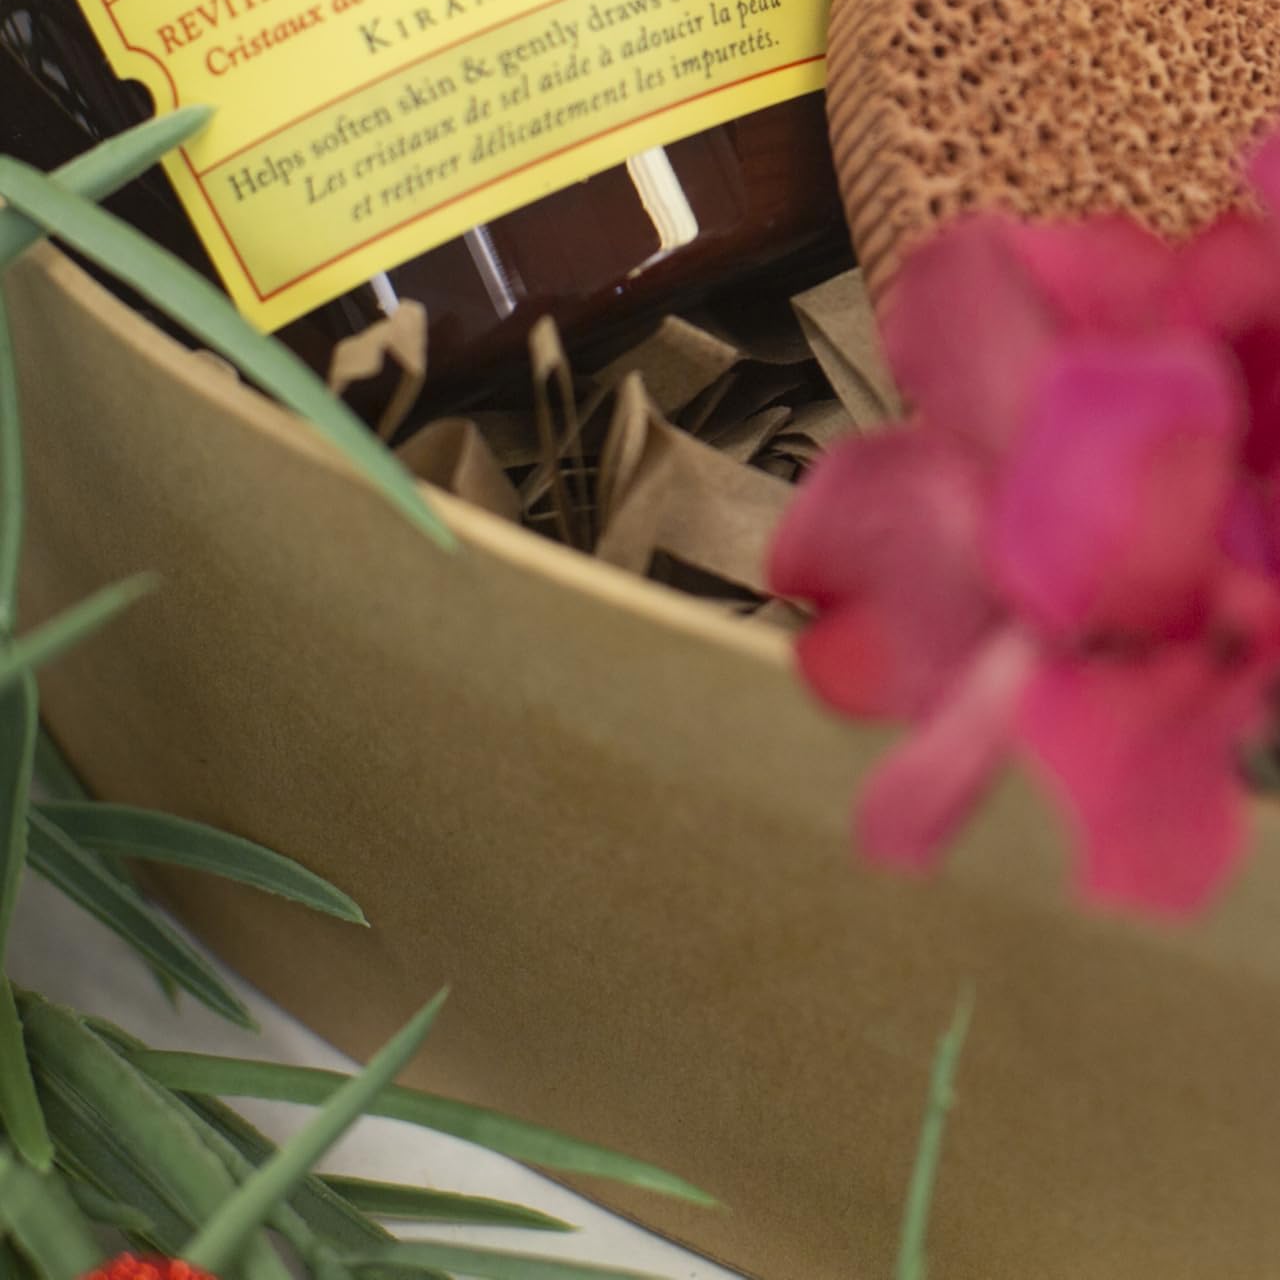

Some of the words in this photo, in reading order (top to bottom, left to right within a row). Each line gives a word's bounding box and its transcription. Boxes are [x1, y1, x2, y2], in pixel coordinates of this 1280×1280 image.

[204, 6, 325, 77] Cristaux
[228, 150, 306, 202] Helps
[311, 106, 393, 161] soften
[398, 74, 457, 115] skin
[463, 56, 493, 85] &
[498, 17, 582, 74] gently
[304, 170, 349, 206] Les
[352, 120, 458, 177] cristaux
[464, 98, 493, 126] de
[499, 81, 533, 108] sel
[537, 56, 591, 91] aide
[597, 44, 615, 69] à
[619, 13, 706, 61] adoucir
[709, 2, 732, 28] la
[351, 195, 374, 222] et
[382, 157, 462, 204] retirer
[468, 84, 630, 162] délicatement
[634, 66, 668, 95] les
